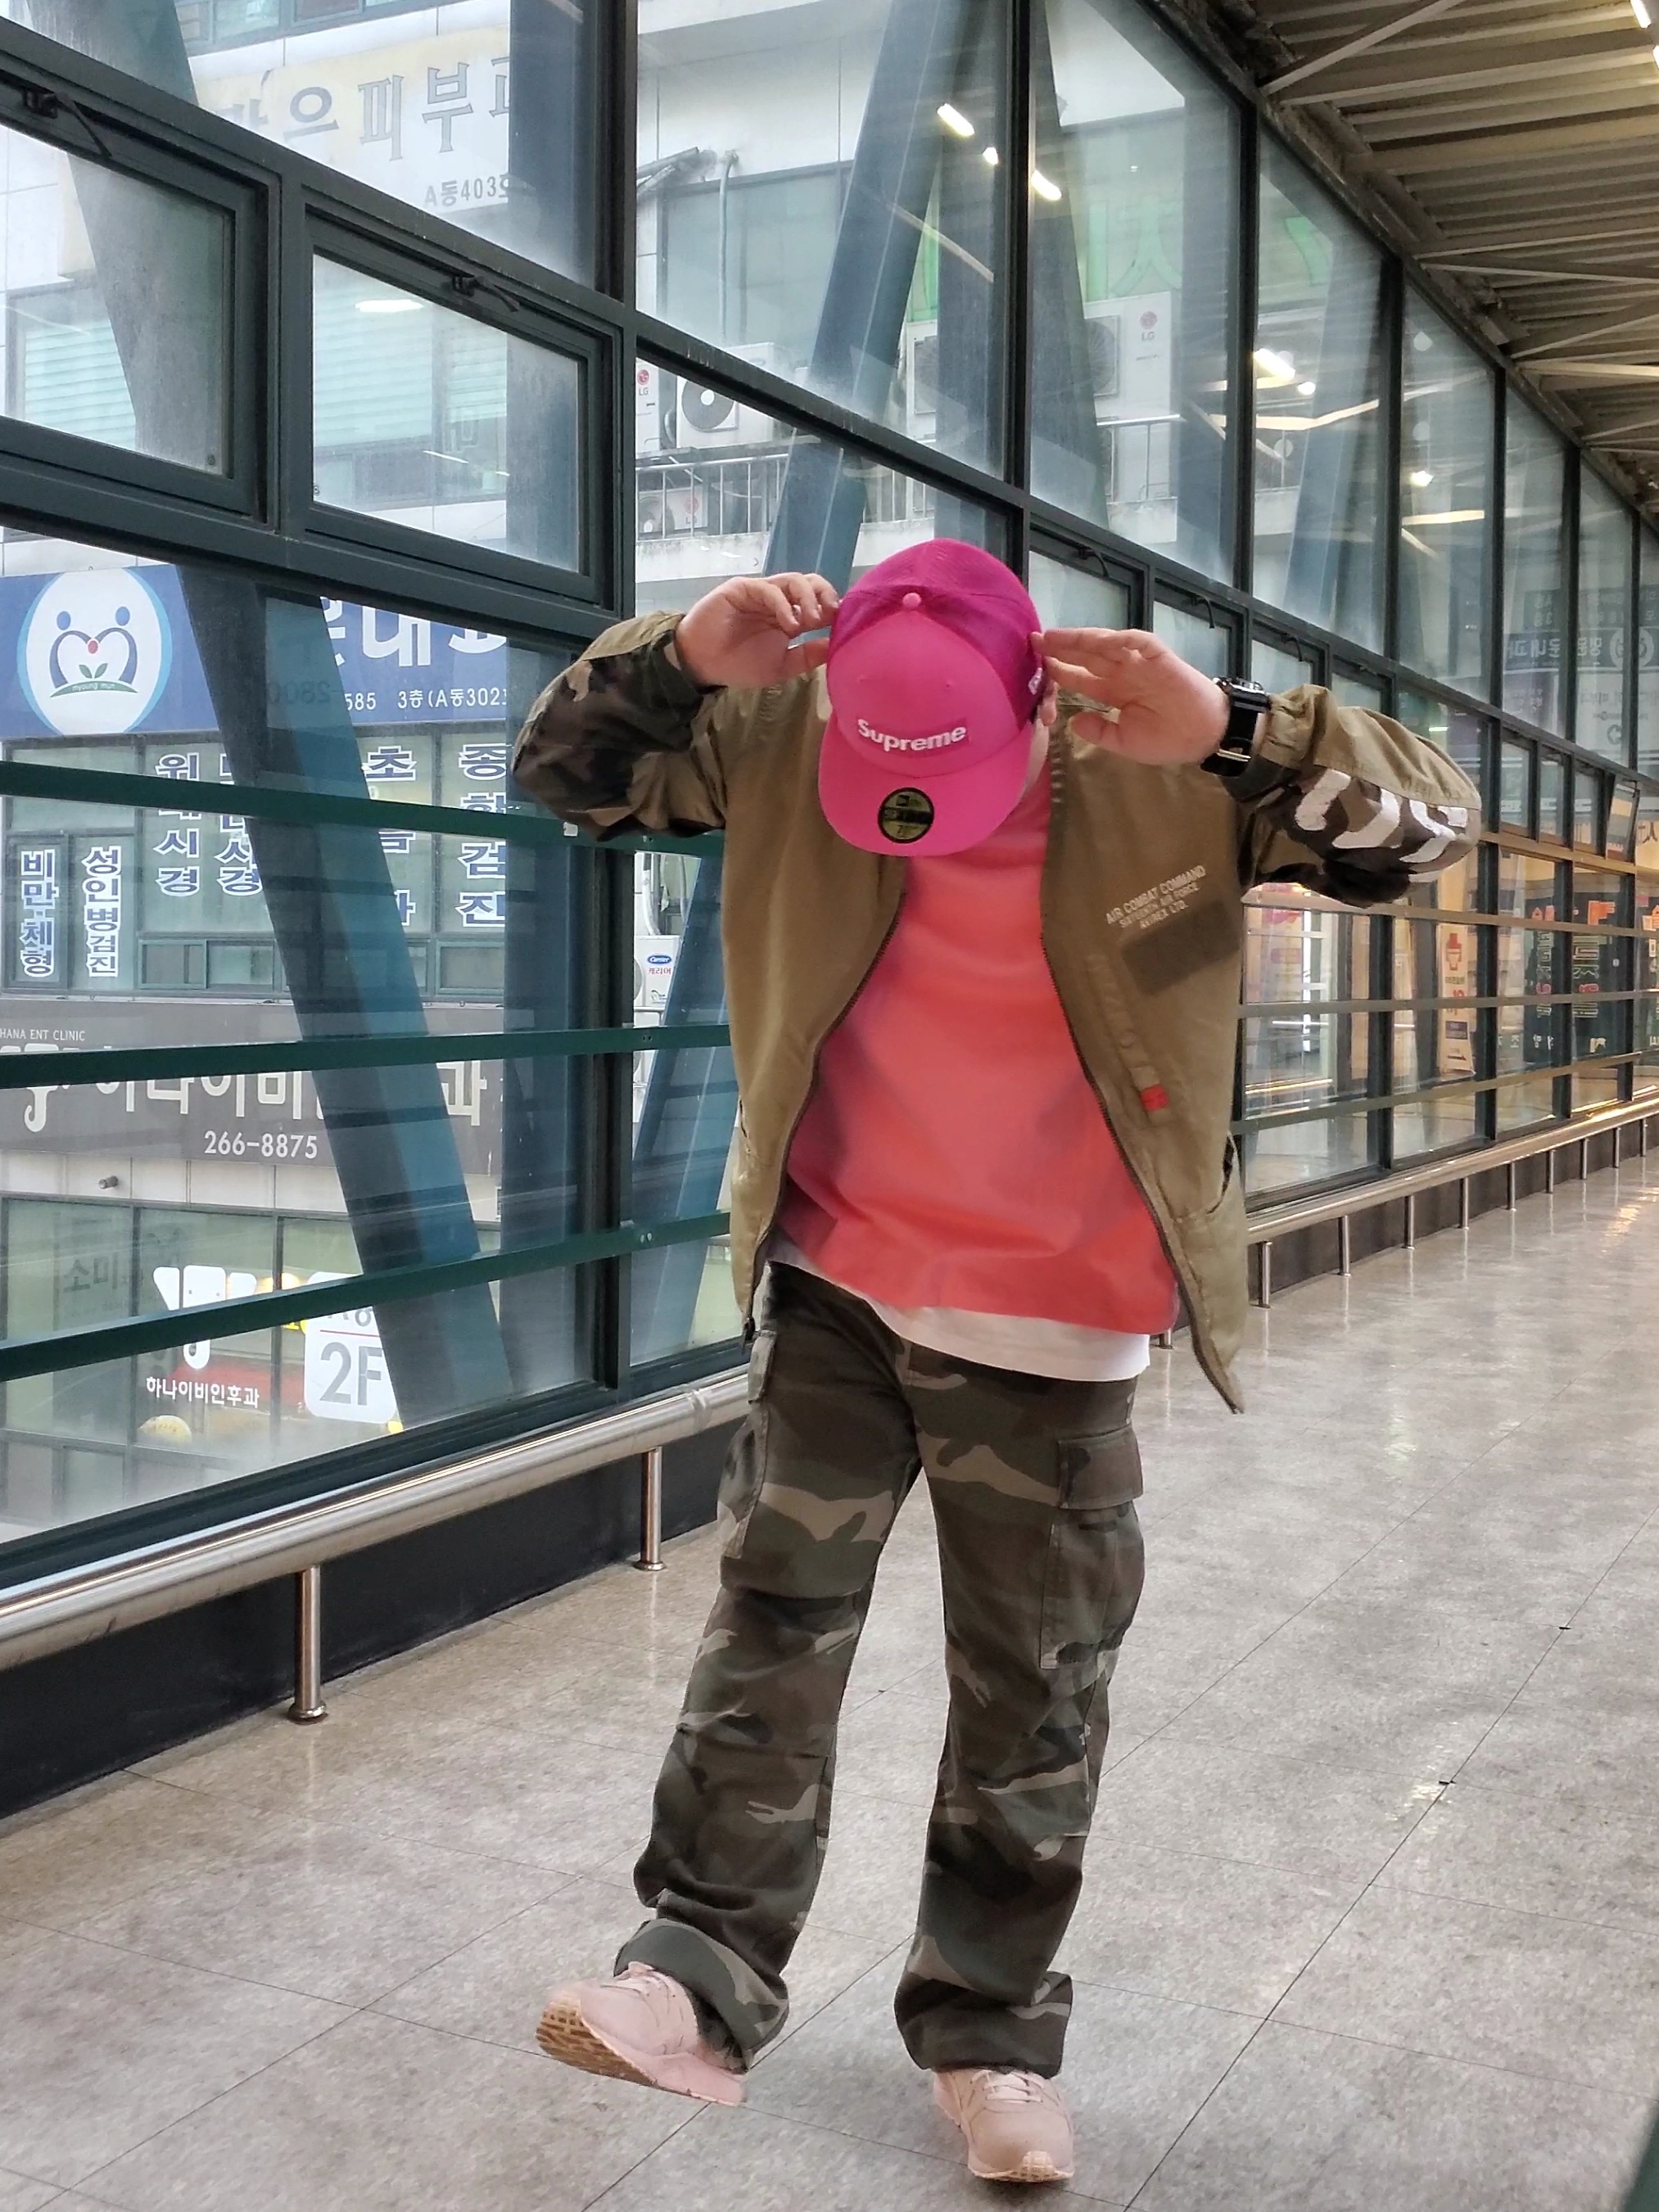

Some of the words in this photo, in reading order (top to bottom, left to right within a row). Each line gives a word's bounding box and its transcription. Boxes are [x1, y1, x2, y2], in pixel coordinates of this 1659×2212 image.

[639, 387, 649, 396] LG
[857, 718, 967, 752] Supreme
[1105, 907, 1124, 924] AIR
[1123, 887, 1159, 914] COMBAT
[1159, 864, 1206, 894] COMMAND
[81, 846, 122, 977] 성인병검진
[0, 1027, 26, 1039] HANA
[29, 1029, 49, 1041] ENT
[52, 1030, 86, 1041] CLINIC
[204, 1131, 318, 1159] 266-8875
[319, 1341, 383, 1406] 2F
[146, 1376, 260, 1409] 하나이비인후과
